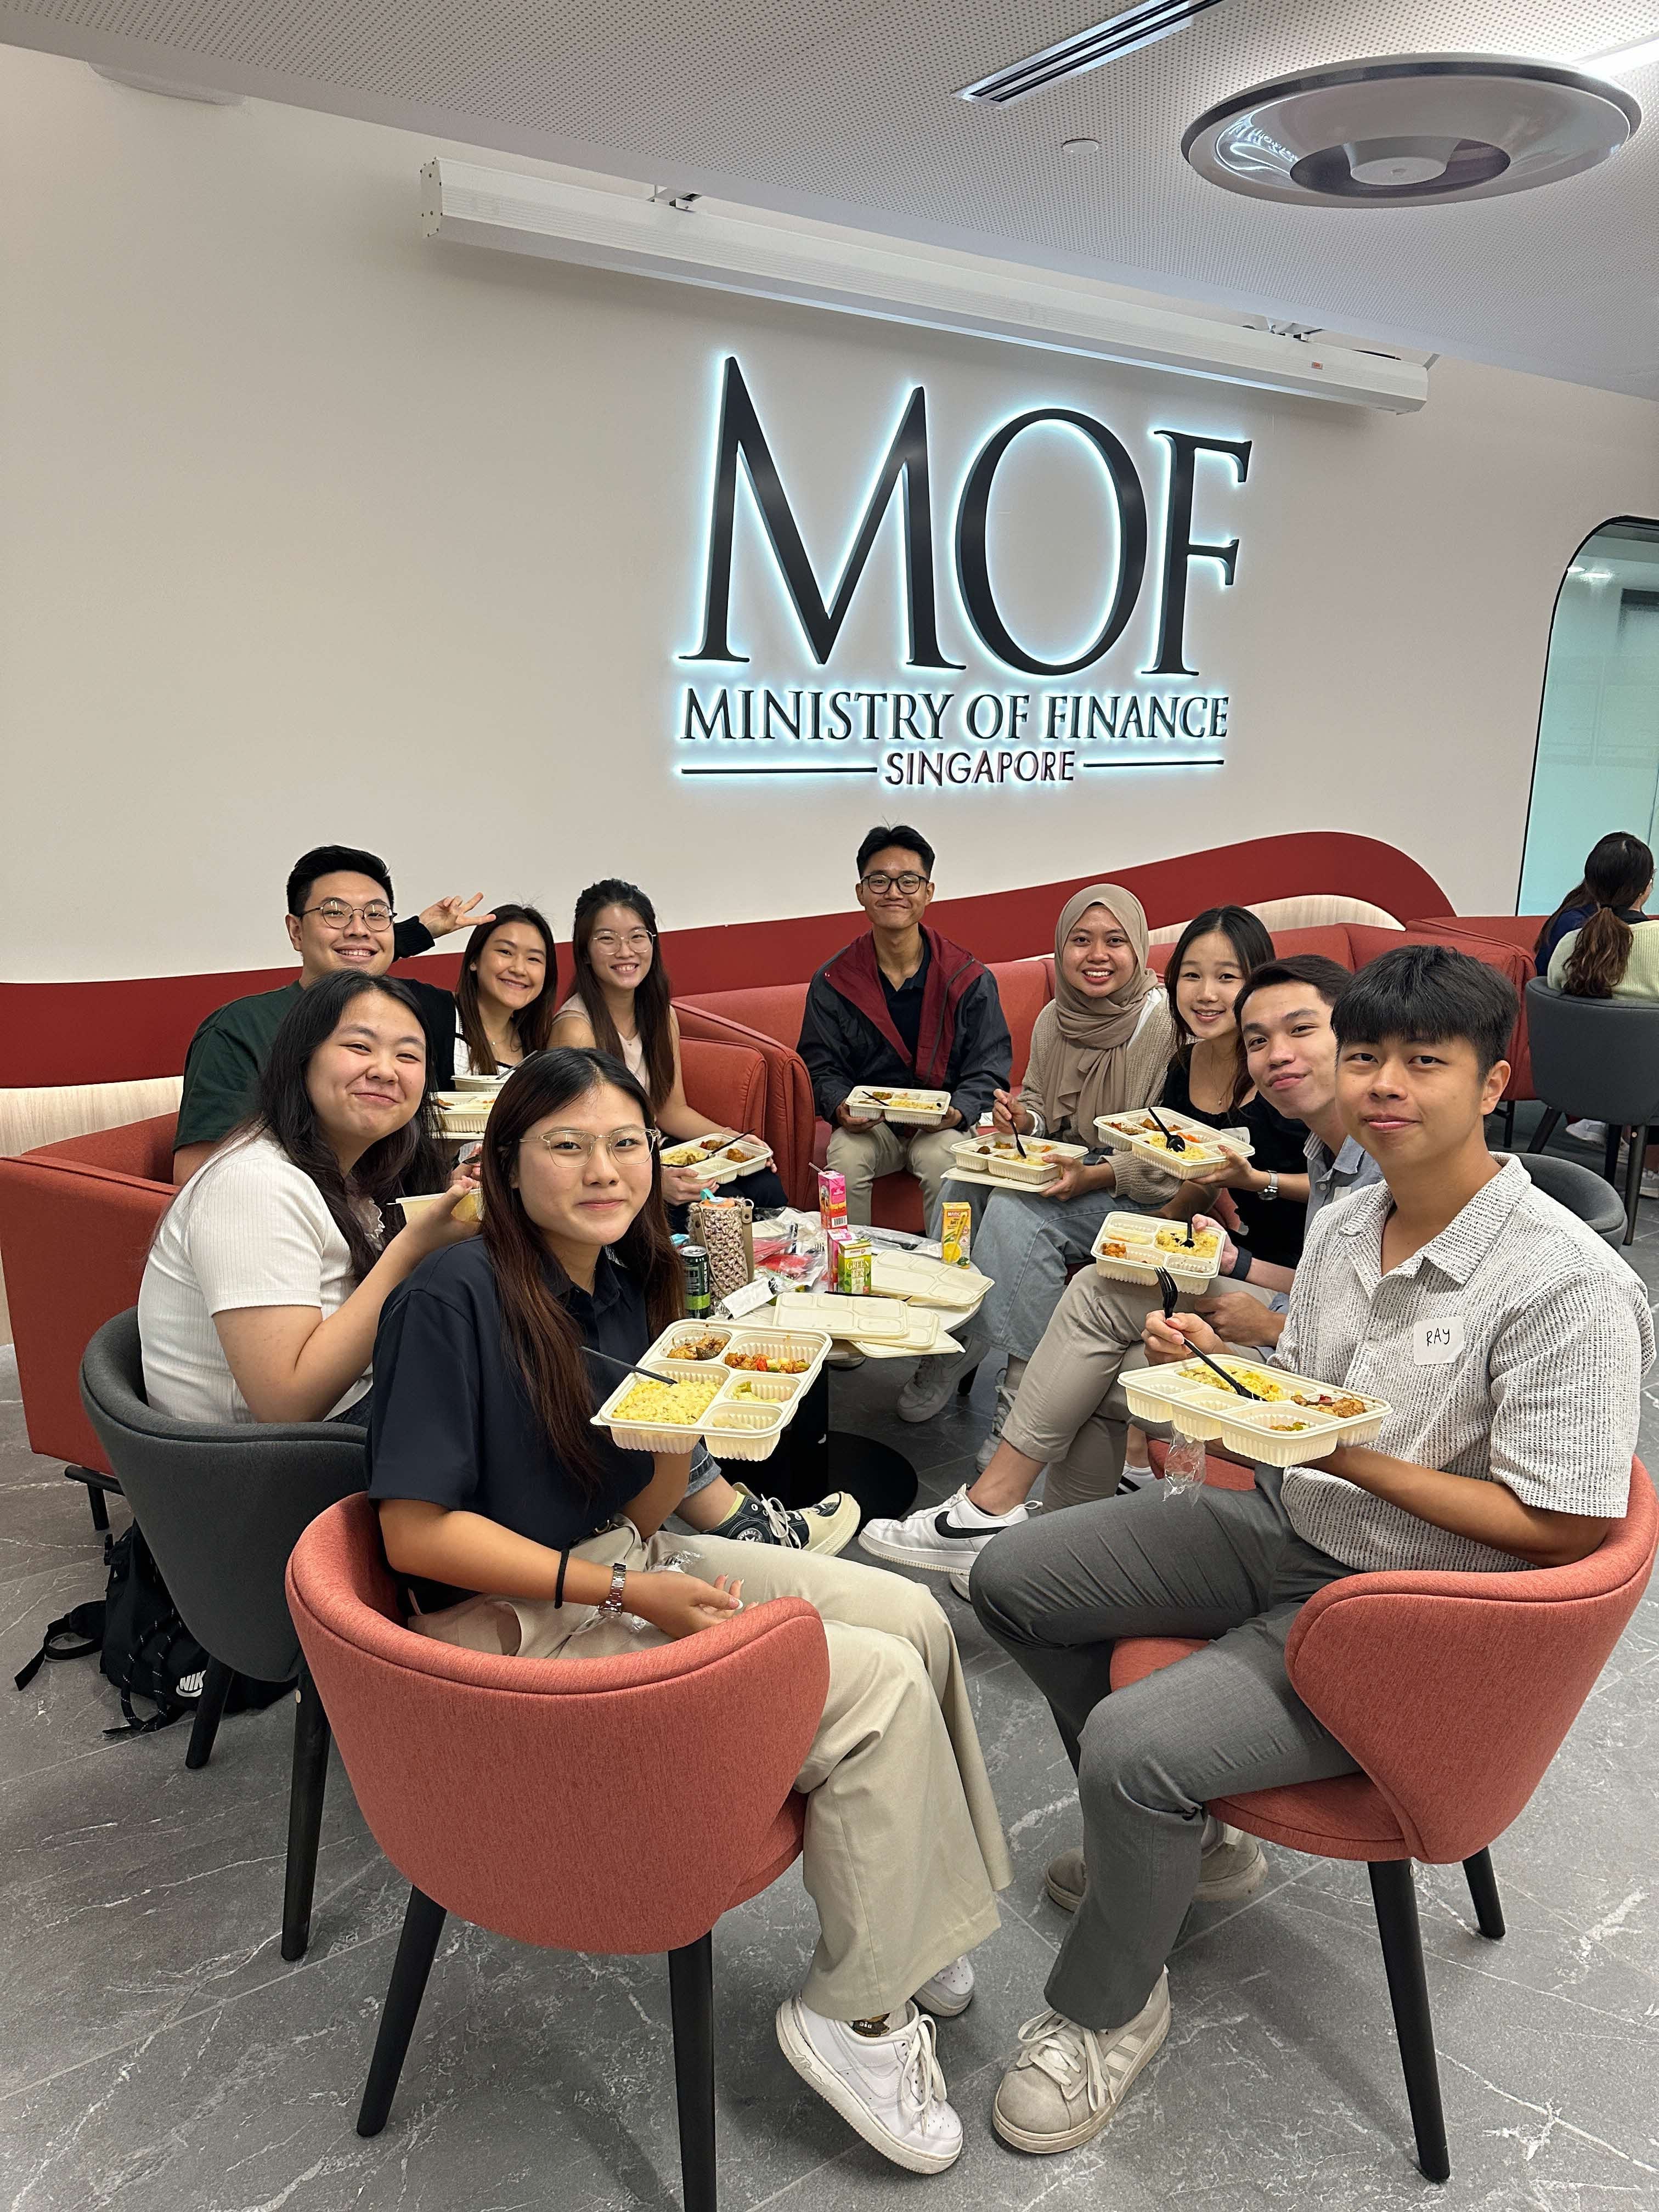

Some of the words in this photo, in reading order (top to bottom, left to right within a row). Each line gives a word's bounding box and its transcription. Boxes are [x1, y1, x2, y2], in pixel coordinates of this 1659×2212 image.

[679, 356, 1252, 676] MOF
[680, 687, 955, 741] MINISTRY
[965, 694, 1030, 740] OF
[1045, 696, 1230, 740] FINANCE
[885, 750, 1076, 786] SINGAPORE
[847, 1260, 870, 1270] GREEN
[852, 1268, 865, 1278] TEA
[1426, 1328, 1450, 1347] RAY
[179, 1669, 207, 1691] NIK
